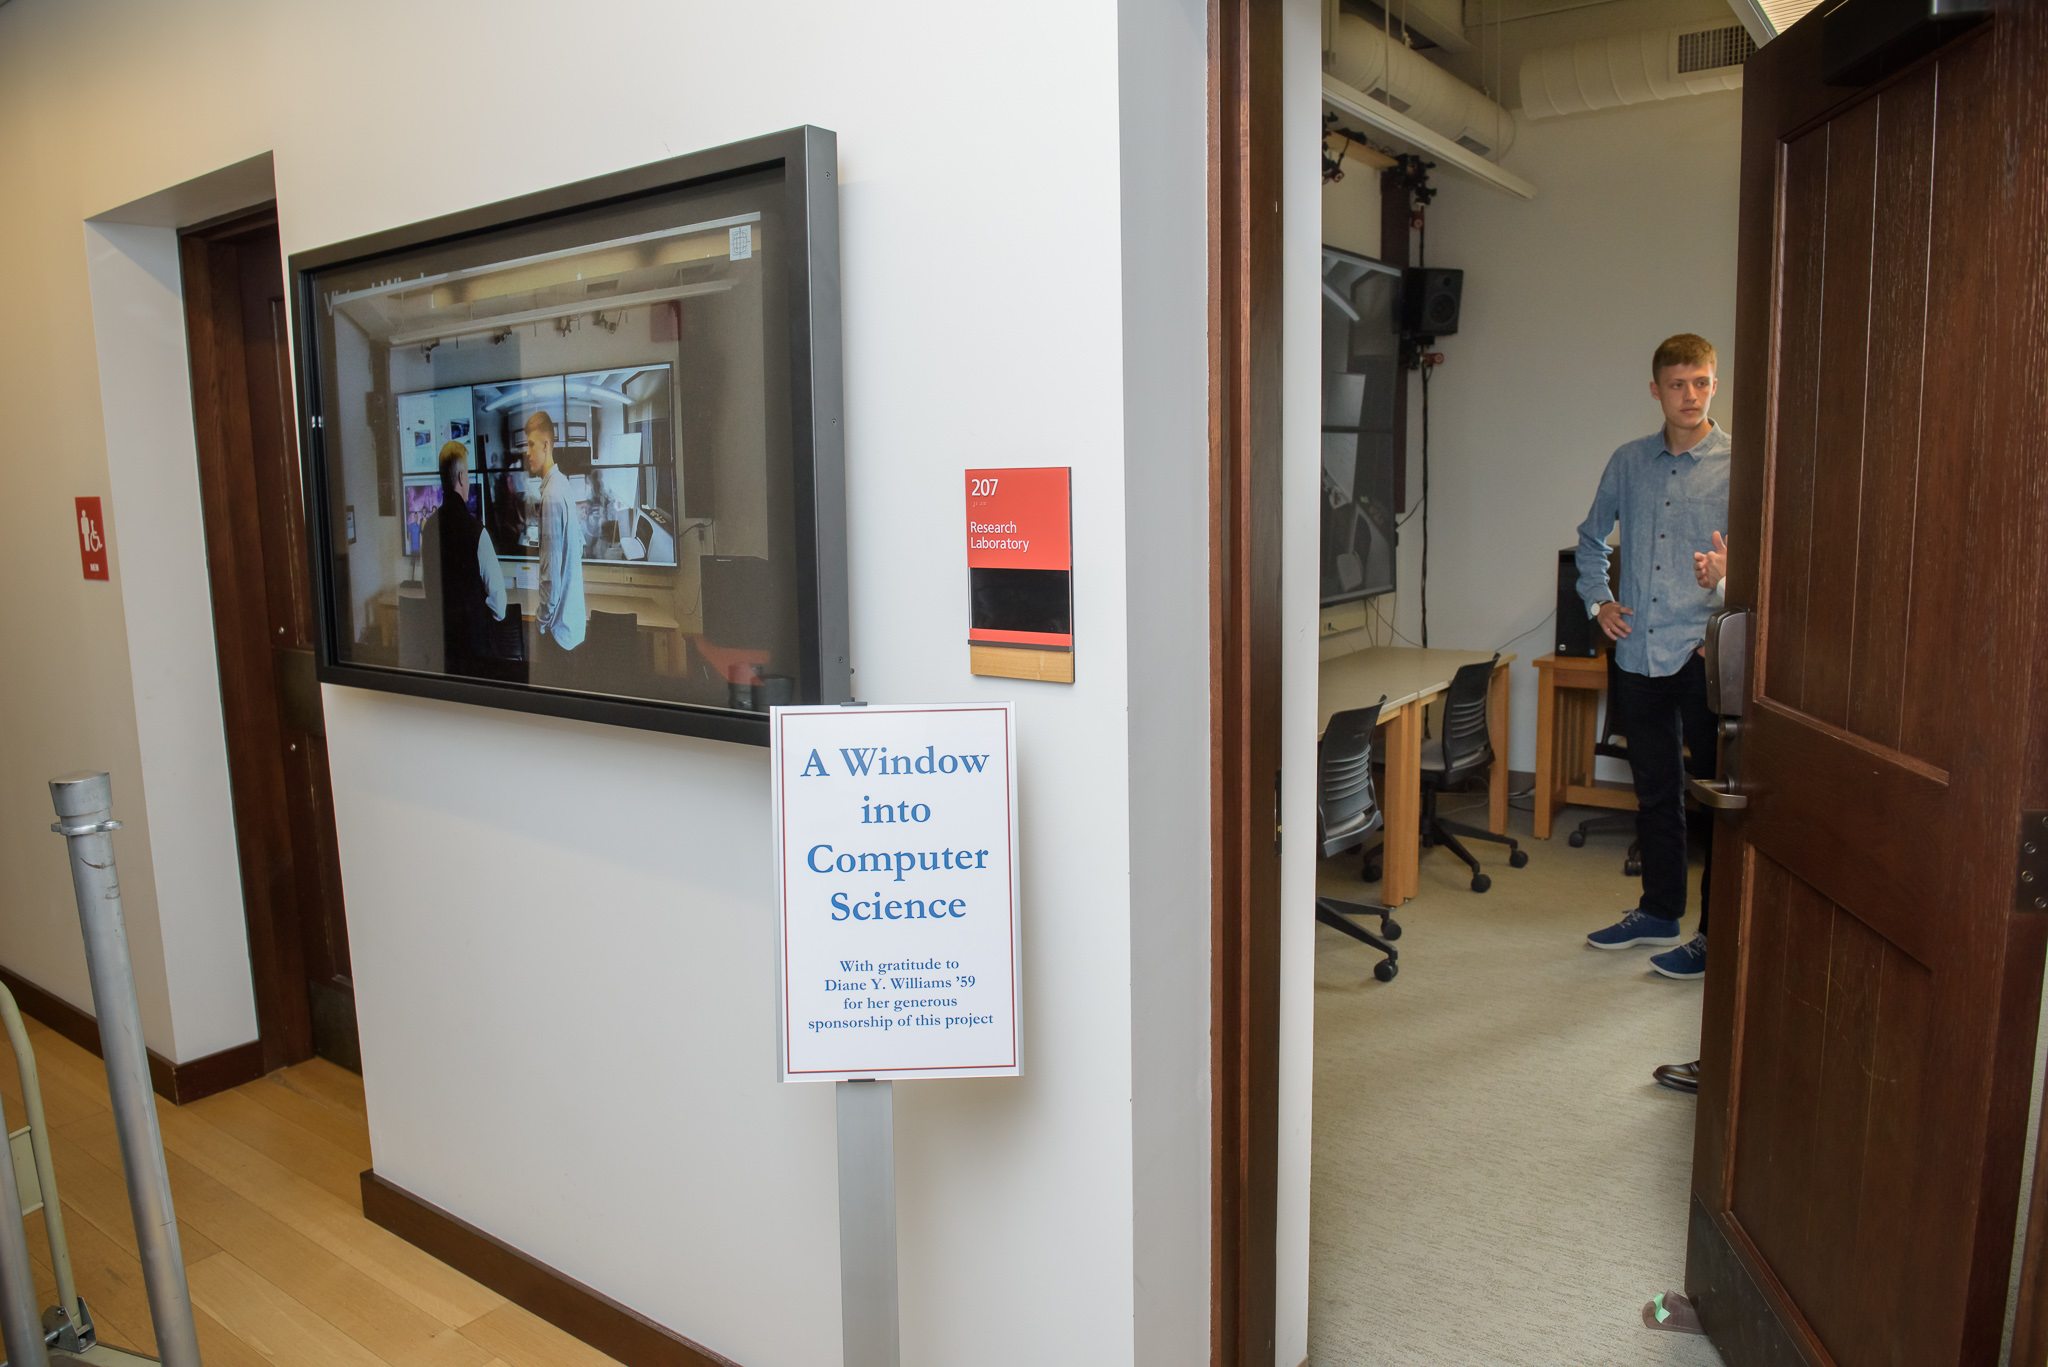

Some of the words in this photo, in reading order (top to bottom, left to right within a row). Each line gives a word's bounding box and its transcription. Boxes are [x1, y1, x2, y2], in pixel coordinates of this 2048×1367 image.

[971, 478, 999, 497] 207
[970, 521, 1017, 534] Research
[970, 537, 1030, 553] Laboratory
[90, 563, 99, 571] MEN
[800, 748, 830, 778] A
[839, 745, 990, 777] Window
[861, 795, 931, 824] into
[807, 844, 989, 882] Computer
[830, 891, 967, 921] Science
[839, 959, 874, 973] With
[878, 958, 942, 976] gratitude
[945, 960, 960, 970] to
[824, 978, 867, 992] Diane
[870, 978, 886, 991] Y.
[889, 976, 952, 990] Williams
[843, 997, 863, 1010] for
[866, 997, 890, 1009] her
[893, 998, 958, 1013] generous
[808, 1015, 893, 1034] sponsorship
[897, 1014, 913, 1027] of
[915, 1014, 941, 1027] this
[945, 1013, 994, 1030] project
